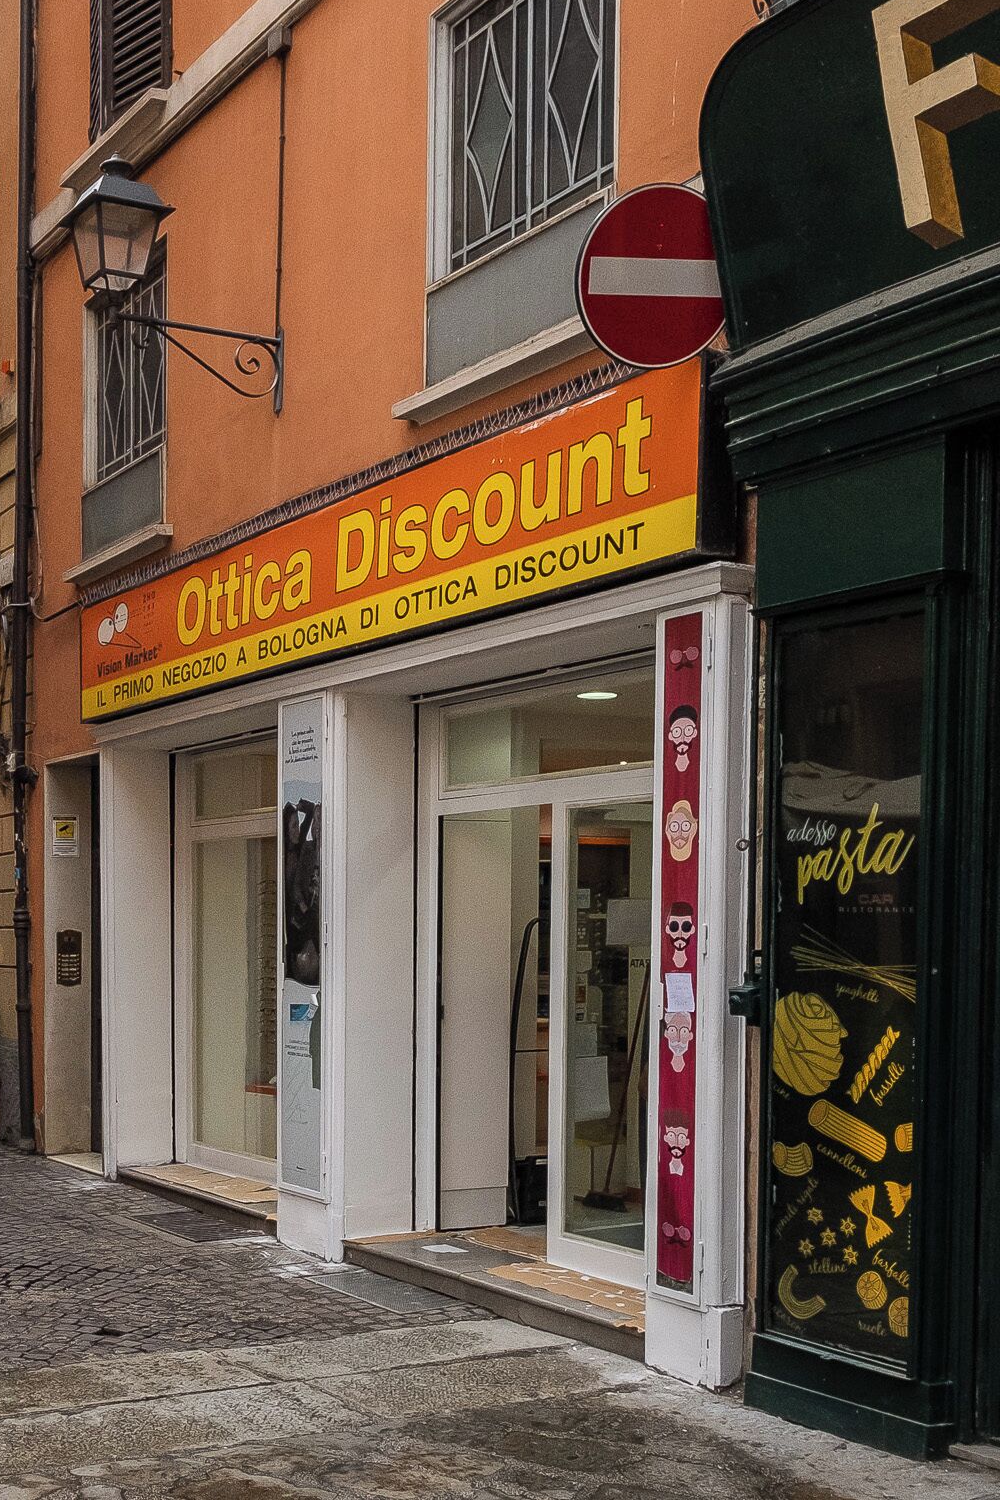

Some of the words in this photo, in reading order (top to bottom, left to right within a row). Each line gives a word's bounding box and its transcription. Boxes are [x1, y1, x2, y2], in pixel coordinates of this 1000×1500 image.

[176, 549, 312, 647] Ottica
[335, 396, 652, 594] Discount
[97, 691, 107, 707] IL
[113, 674, 154, 702] PRIMO
[162, 651, 227, 688] NEGOZIO
[236, 646, 247, 666] A
[258, 615, 347, 660] BOLOGNA
[360, 603, 380, 629] DI
[394, 575, 478, 619] OTTICA
[495, 522, 645, 590] DISCOUNT
[96, 655, 122, 677] Vision
[786, 816, 837, 846] adesso
[797, 802, 916, 905] pasta
[816, 1142, 869, 1180] cannelloni
[807, 1257, 848, 1274] stelline
